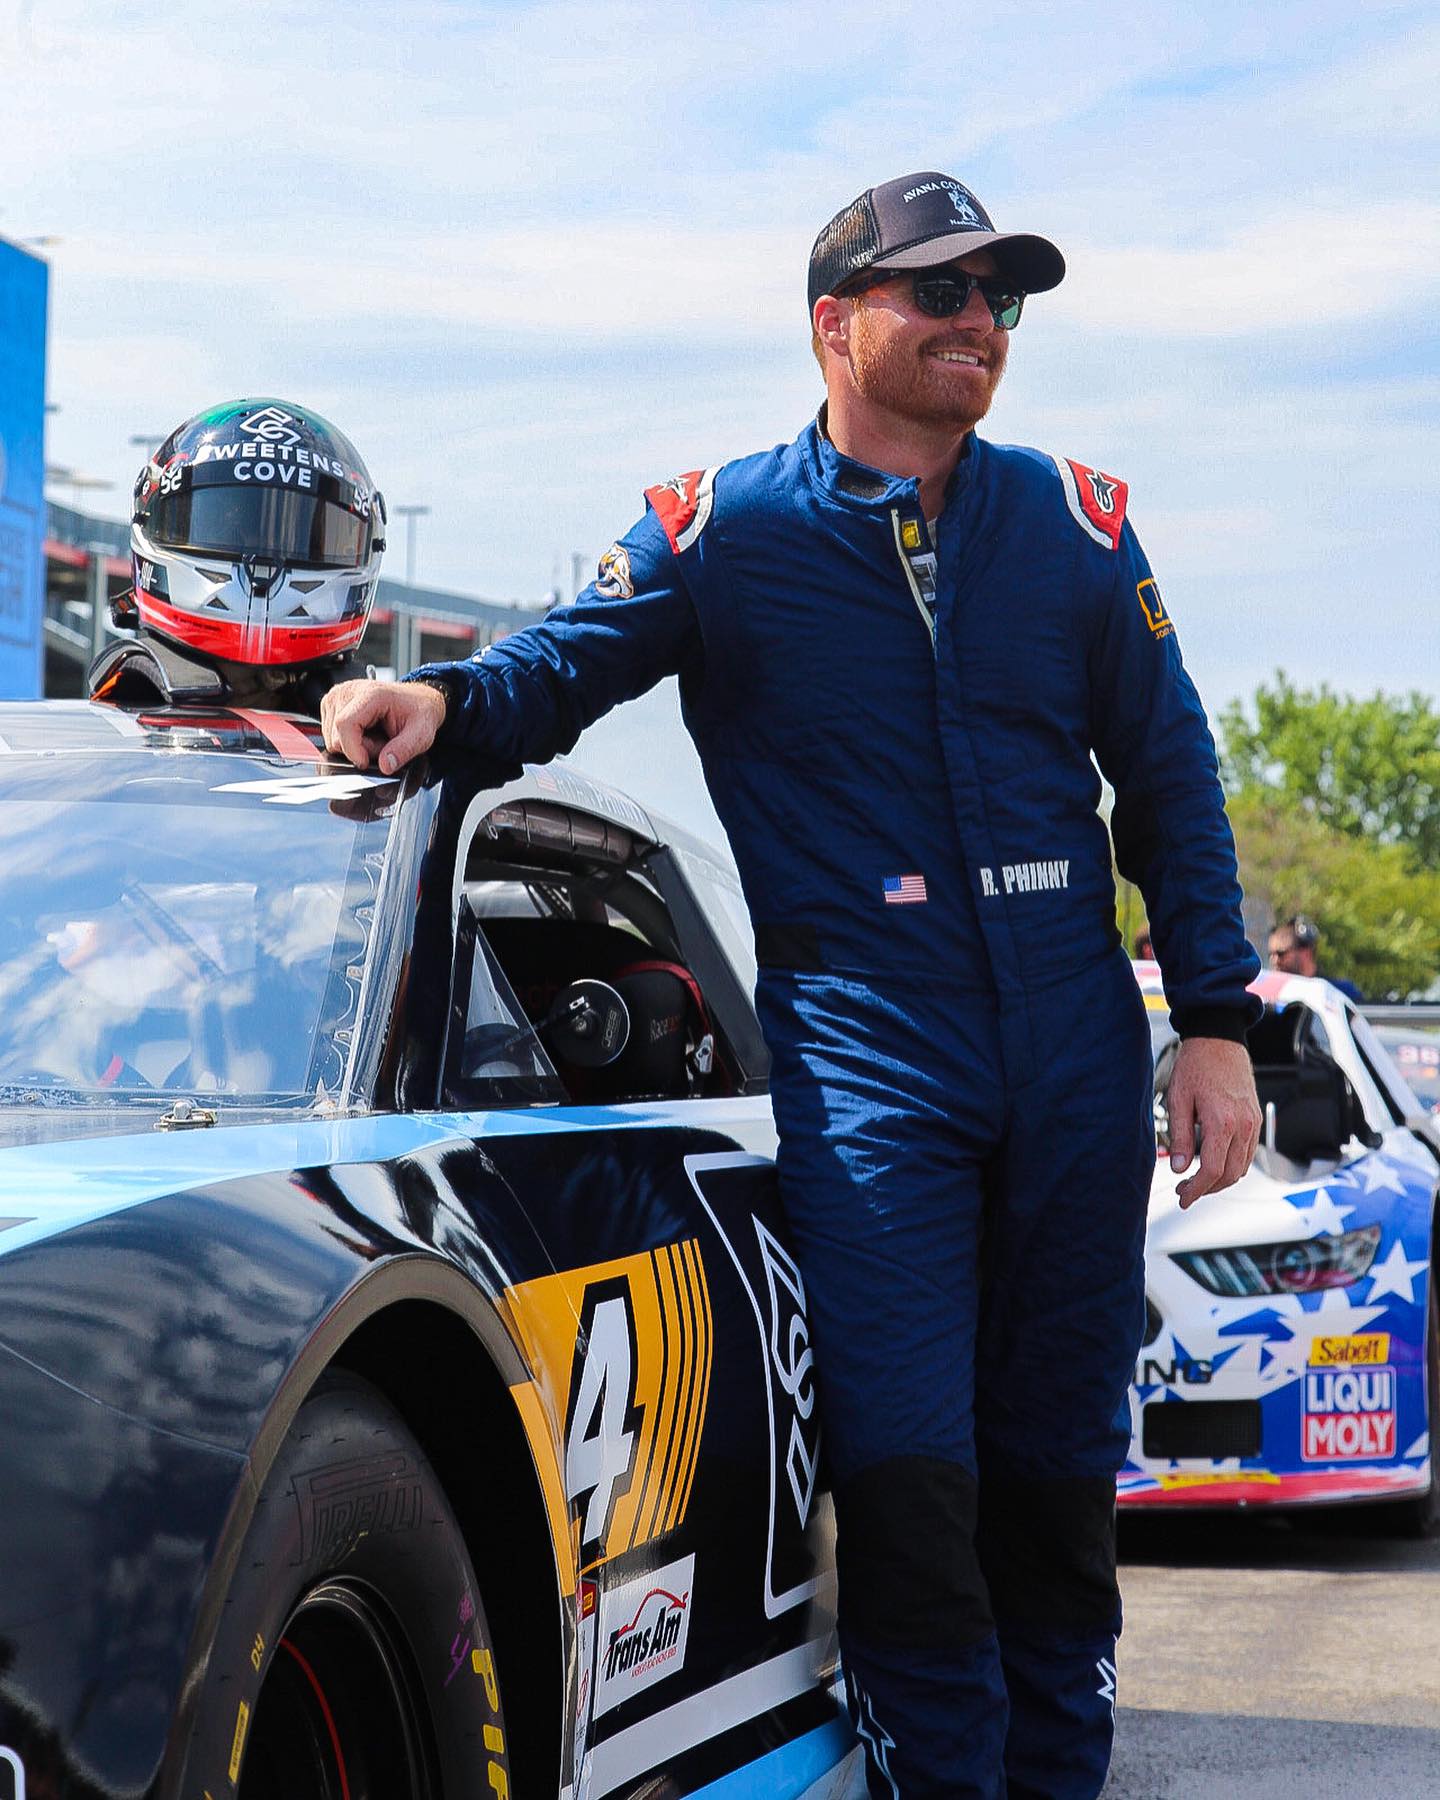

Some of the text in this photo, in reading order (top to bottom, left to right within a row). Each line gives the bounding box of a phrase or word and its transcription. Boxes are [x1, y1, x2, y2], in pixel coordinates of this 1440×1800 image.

[195, 442, 344, 477] WEETENS
[234, 461, 311, 488] COVE
[979, 859, 1070, 897] R. PHINNY
[1132, 1359, 1212, 1385] NG
[1307, 1371, 1391, 1414] LIQUI
[566, 1296, 635, 1545] 4
[1307, 1415, 1393, 1457] MOLY
[605, 1628, 652, 1682] Trans
[648, 1605, 682, 1659] Am
